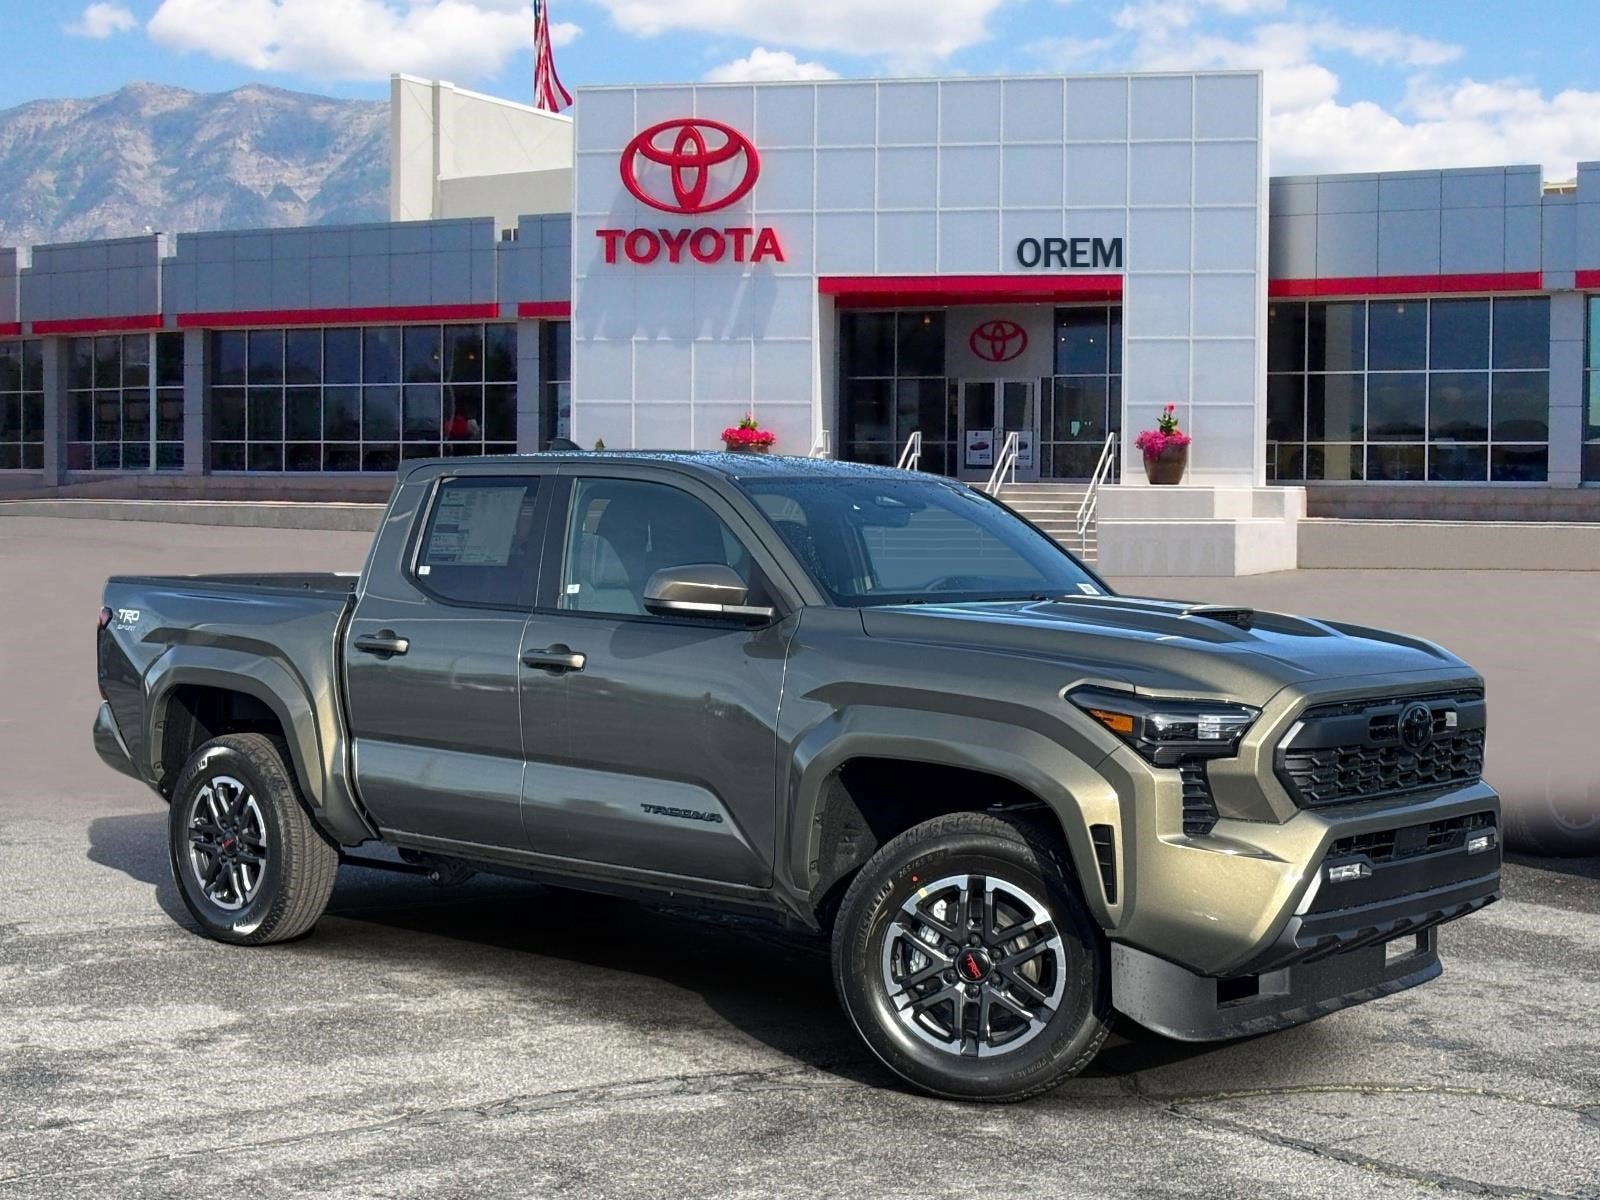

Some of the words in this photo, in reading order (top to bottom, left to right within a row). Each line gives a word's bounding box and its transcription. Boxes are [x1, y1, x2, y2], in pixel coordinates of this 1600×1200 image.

[595, 227, 785, 265] TOYOTA
[1016, 237, 1123, 268] OREM
[118, 608, 140, 623] TRD
[640, 803, 723, 823] TACOMA
